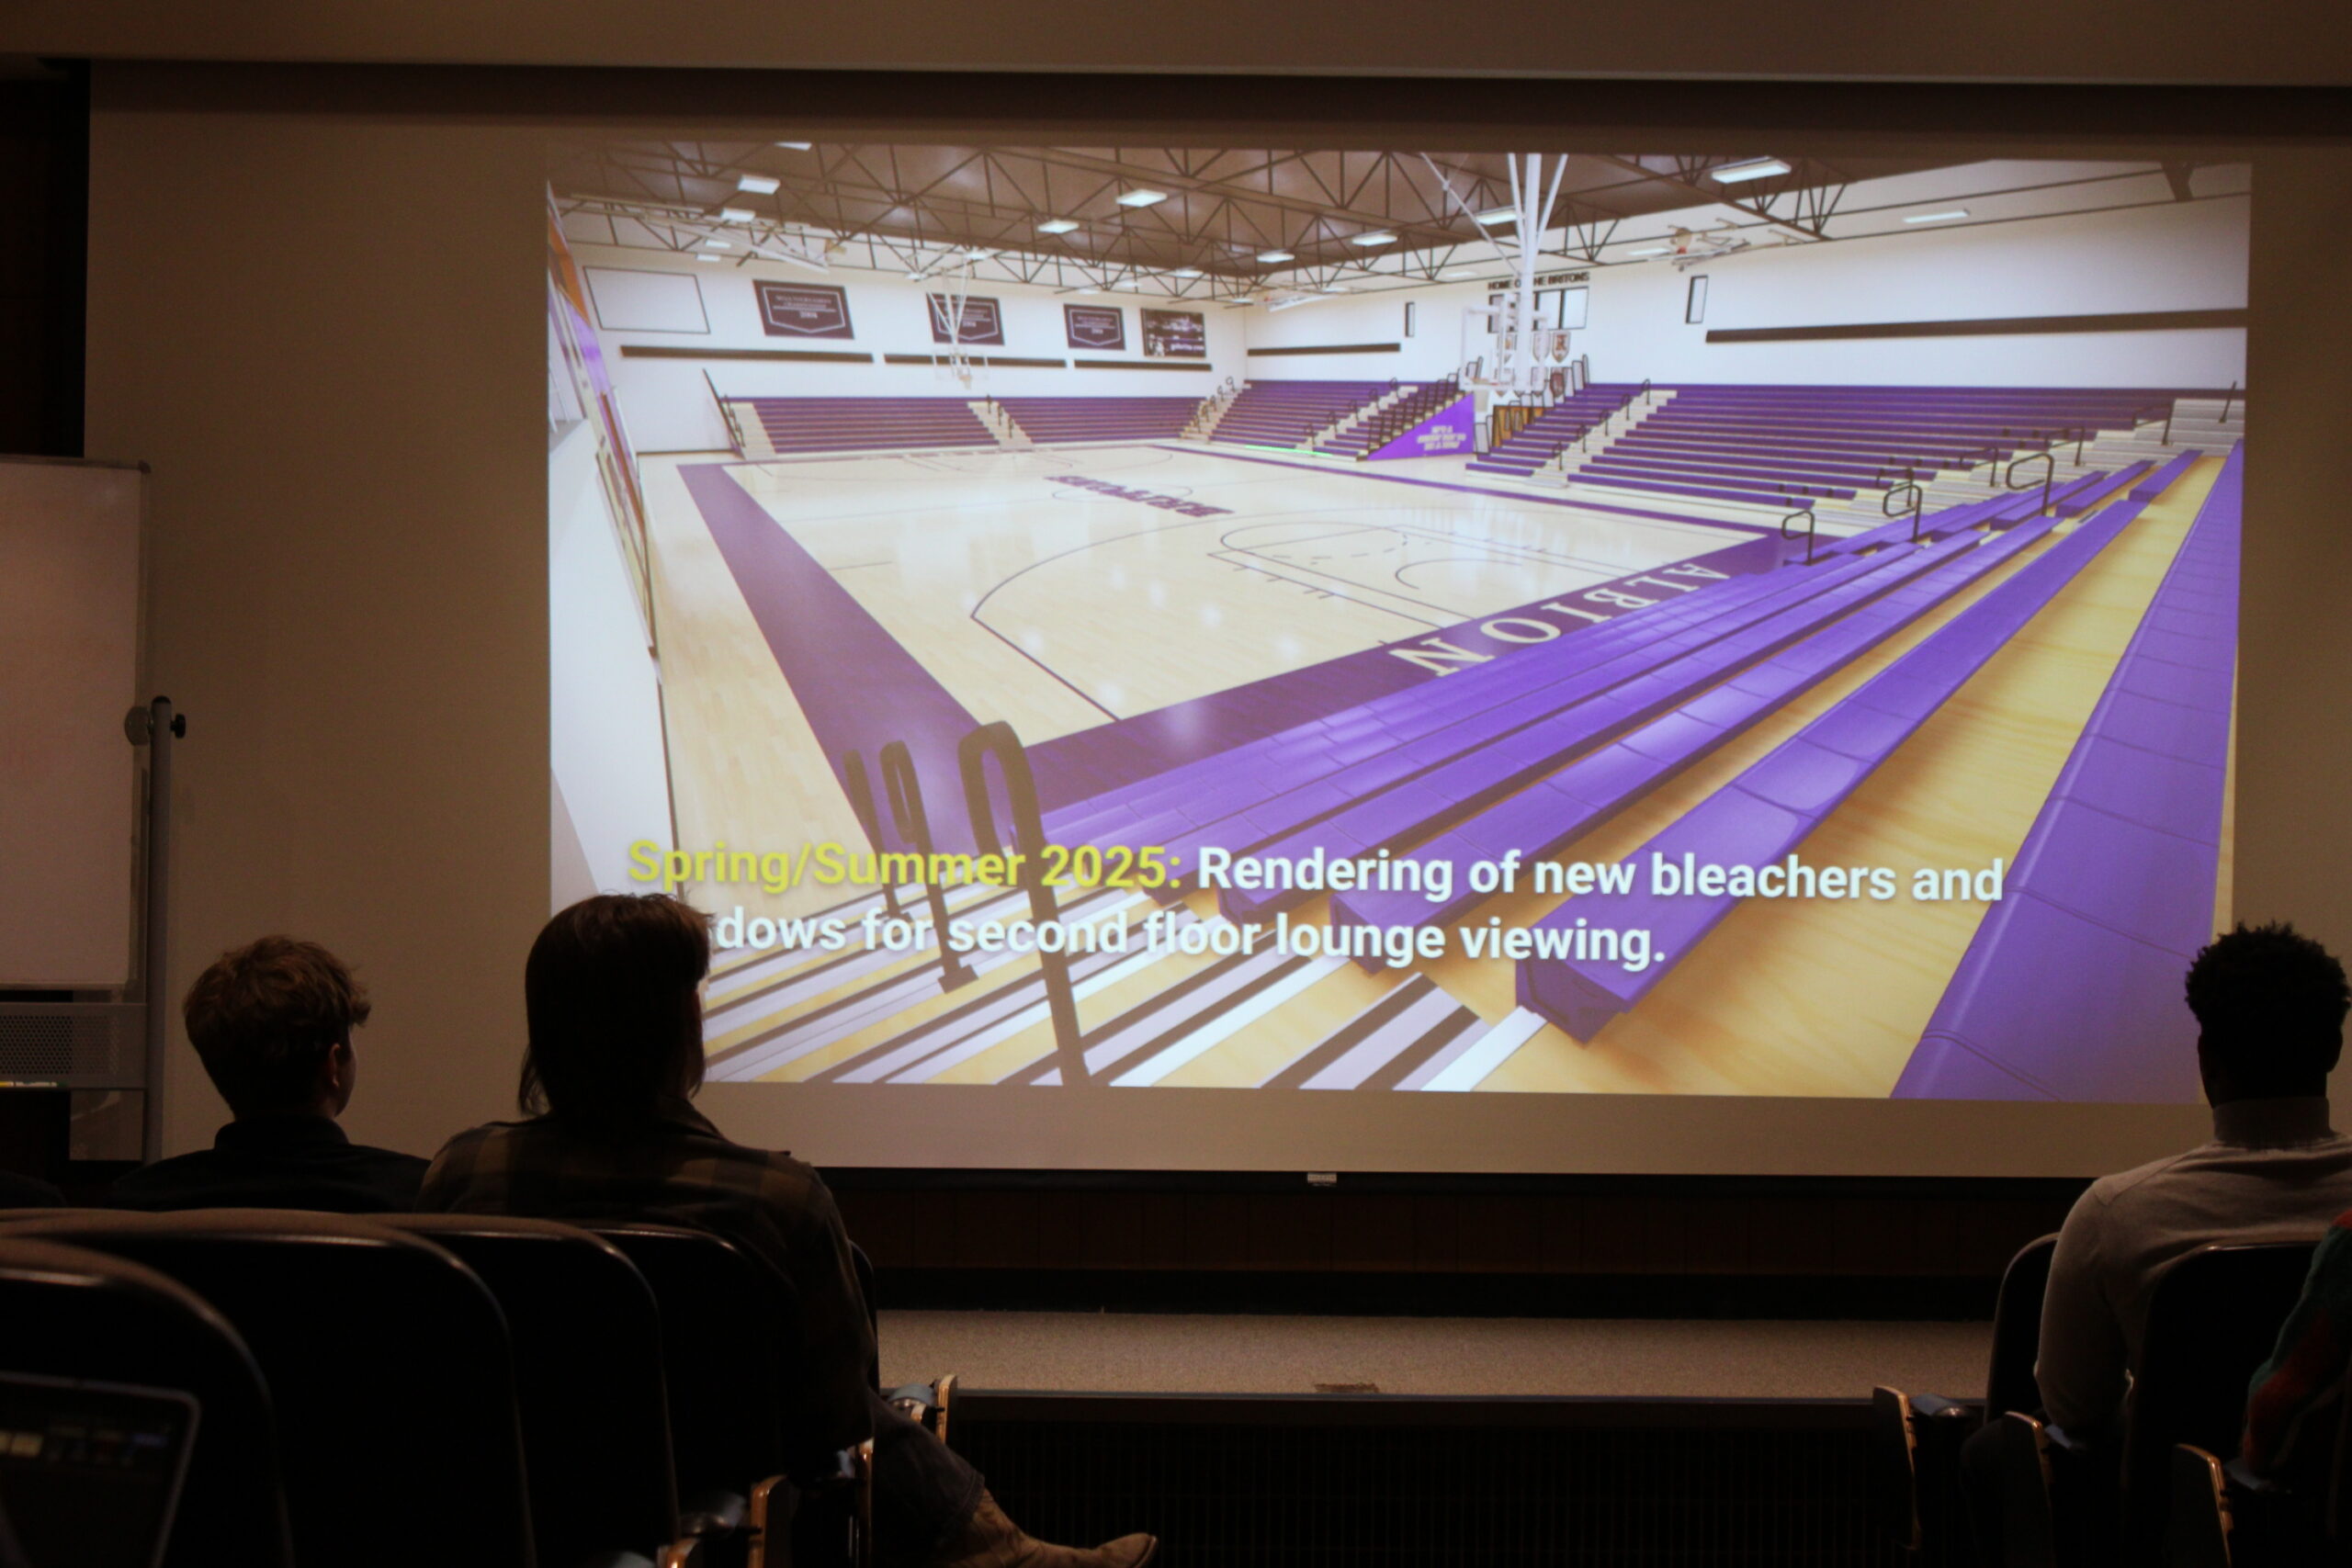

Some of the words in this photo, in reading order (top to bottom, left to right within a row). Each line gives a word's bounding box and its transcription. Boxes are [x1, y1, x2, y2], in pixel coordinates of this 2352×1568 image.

[1487, 279, 1510, 290] HOME
[1548, 272, 1590, 285] BRITONS
[1388, 562, 1731, 677] ALBION
[628, 840, 1027, 895] Spring/Summer
[1040, 844, 1182, 890] 2025:
[1198, 847, 1453, 900] Rendering
[1468, 849, 1521, 893] of
[1534, 862, 1636, 896] new
[1652, 852, 1896, 900] bleachers
[1911, 858, 2005, 902] and
[707, 905, 847, 952] dows
[861, 907, 933, 953] for
[947, 908, 1130, 953] second
[1143, 909, 1263, 955] floor
[1275, 912, 1446, 965] lounge
[1459, 917, 1666, 968] viewing.
